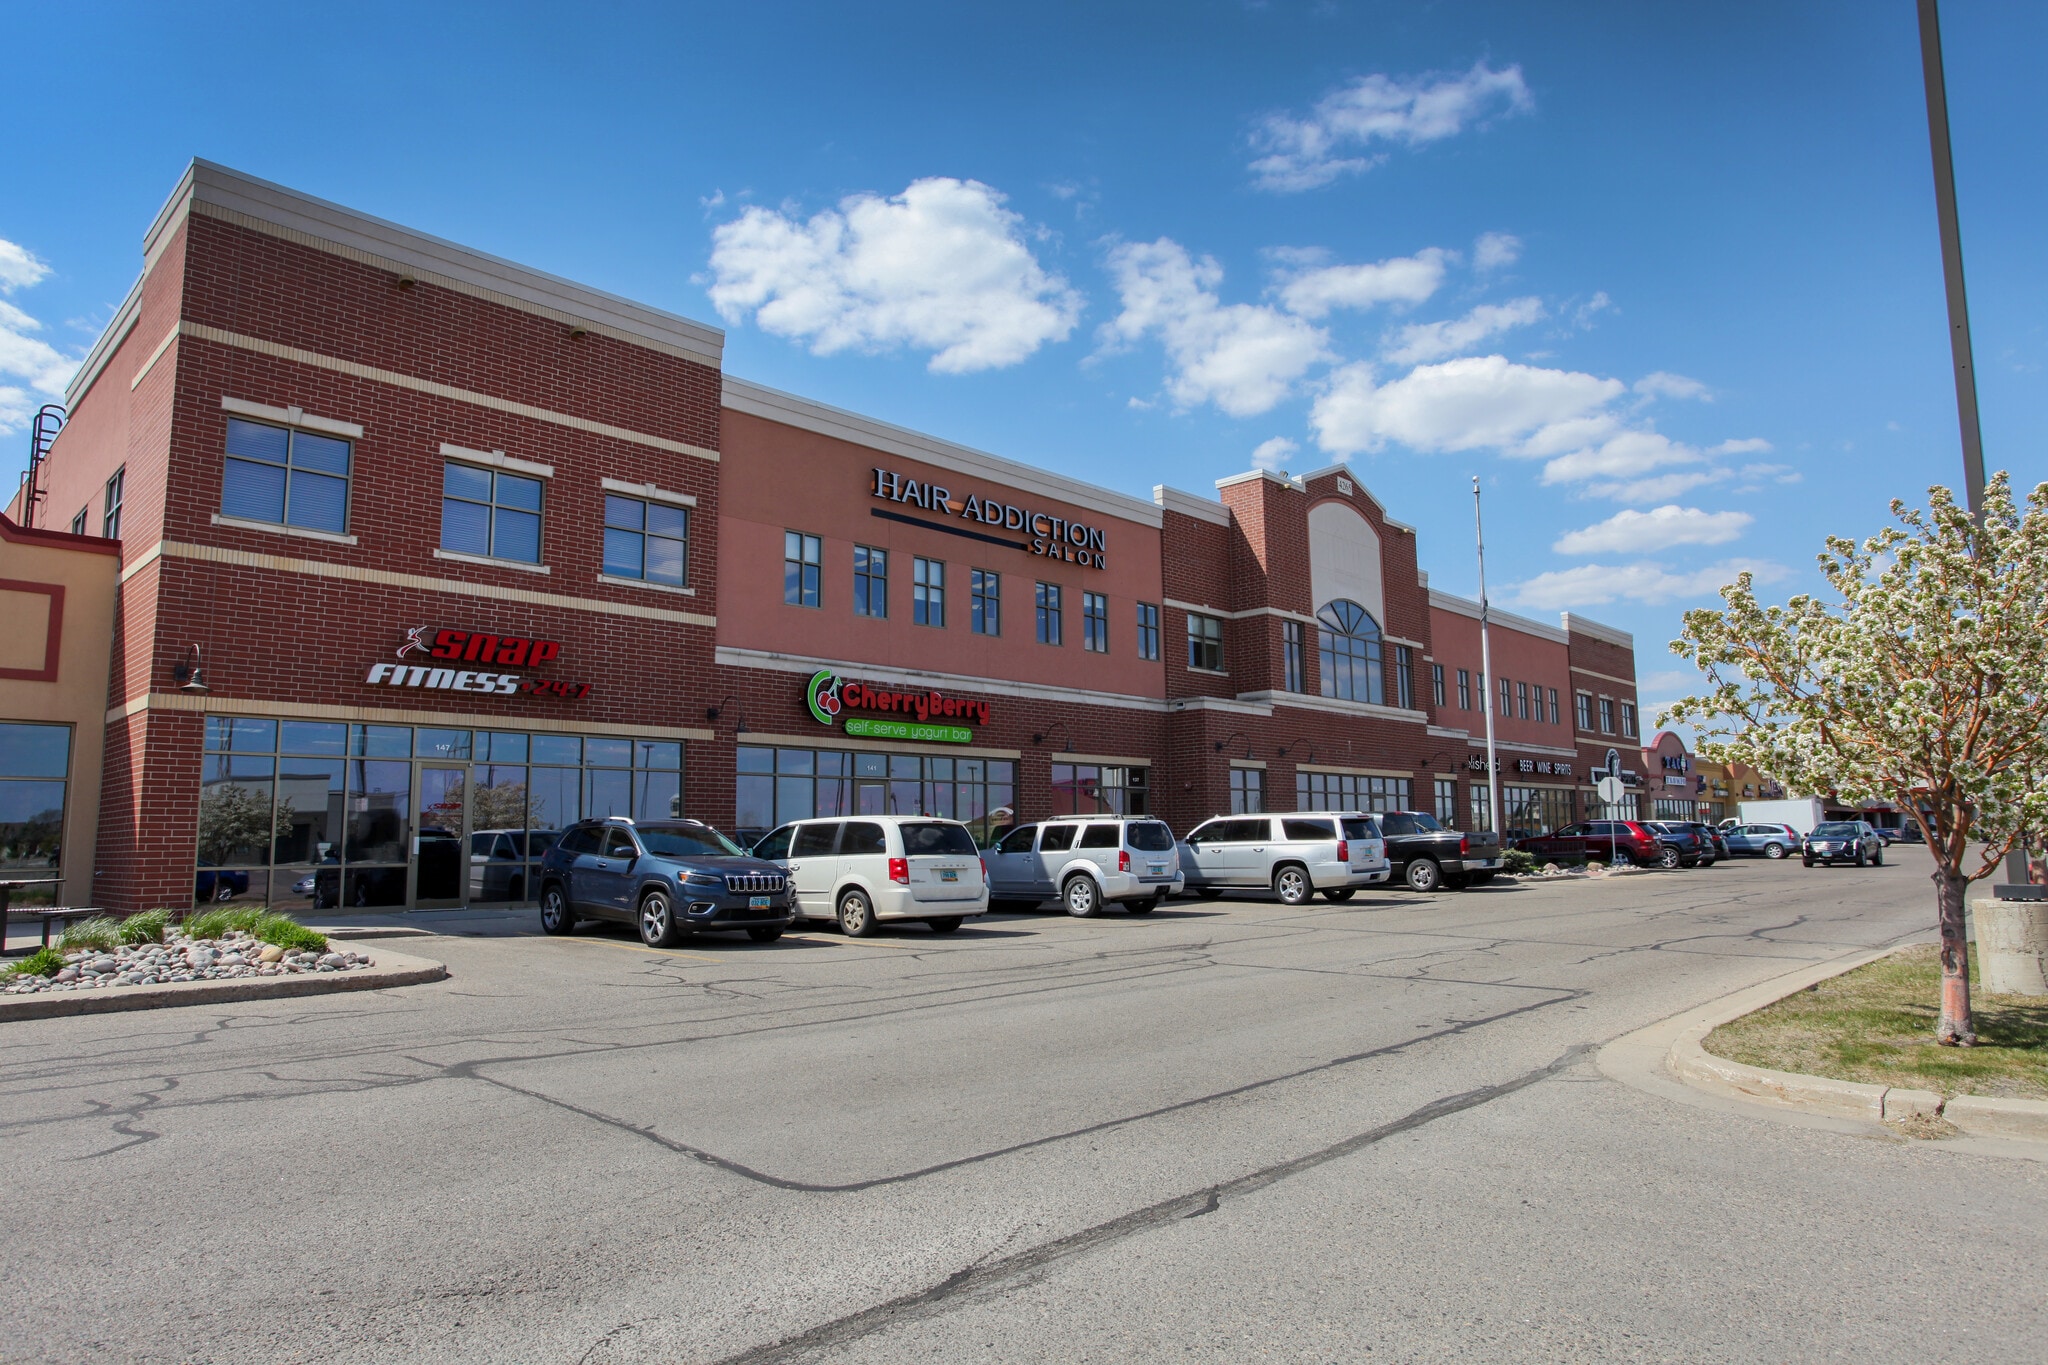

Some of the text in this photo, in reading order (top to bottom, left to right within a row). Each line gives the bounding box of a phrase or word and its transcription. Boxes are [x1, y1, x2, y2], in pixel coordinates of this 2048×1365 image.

[871, 467, 1106, 552] HAIR ADDICTION
[1031, 538, 1107, 570] SALON
[365, 662, 520, 694] FITNESS
[842, 683, 991, 726] CherryBerry
[846, 720, 971, 740] self-serve yogurt bar
[1519, 759, 1572, 776] BEER WINE SPIRITS
